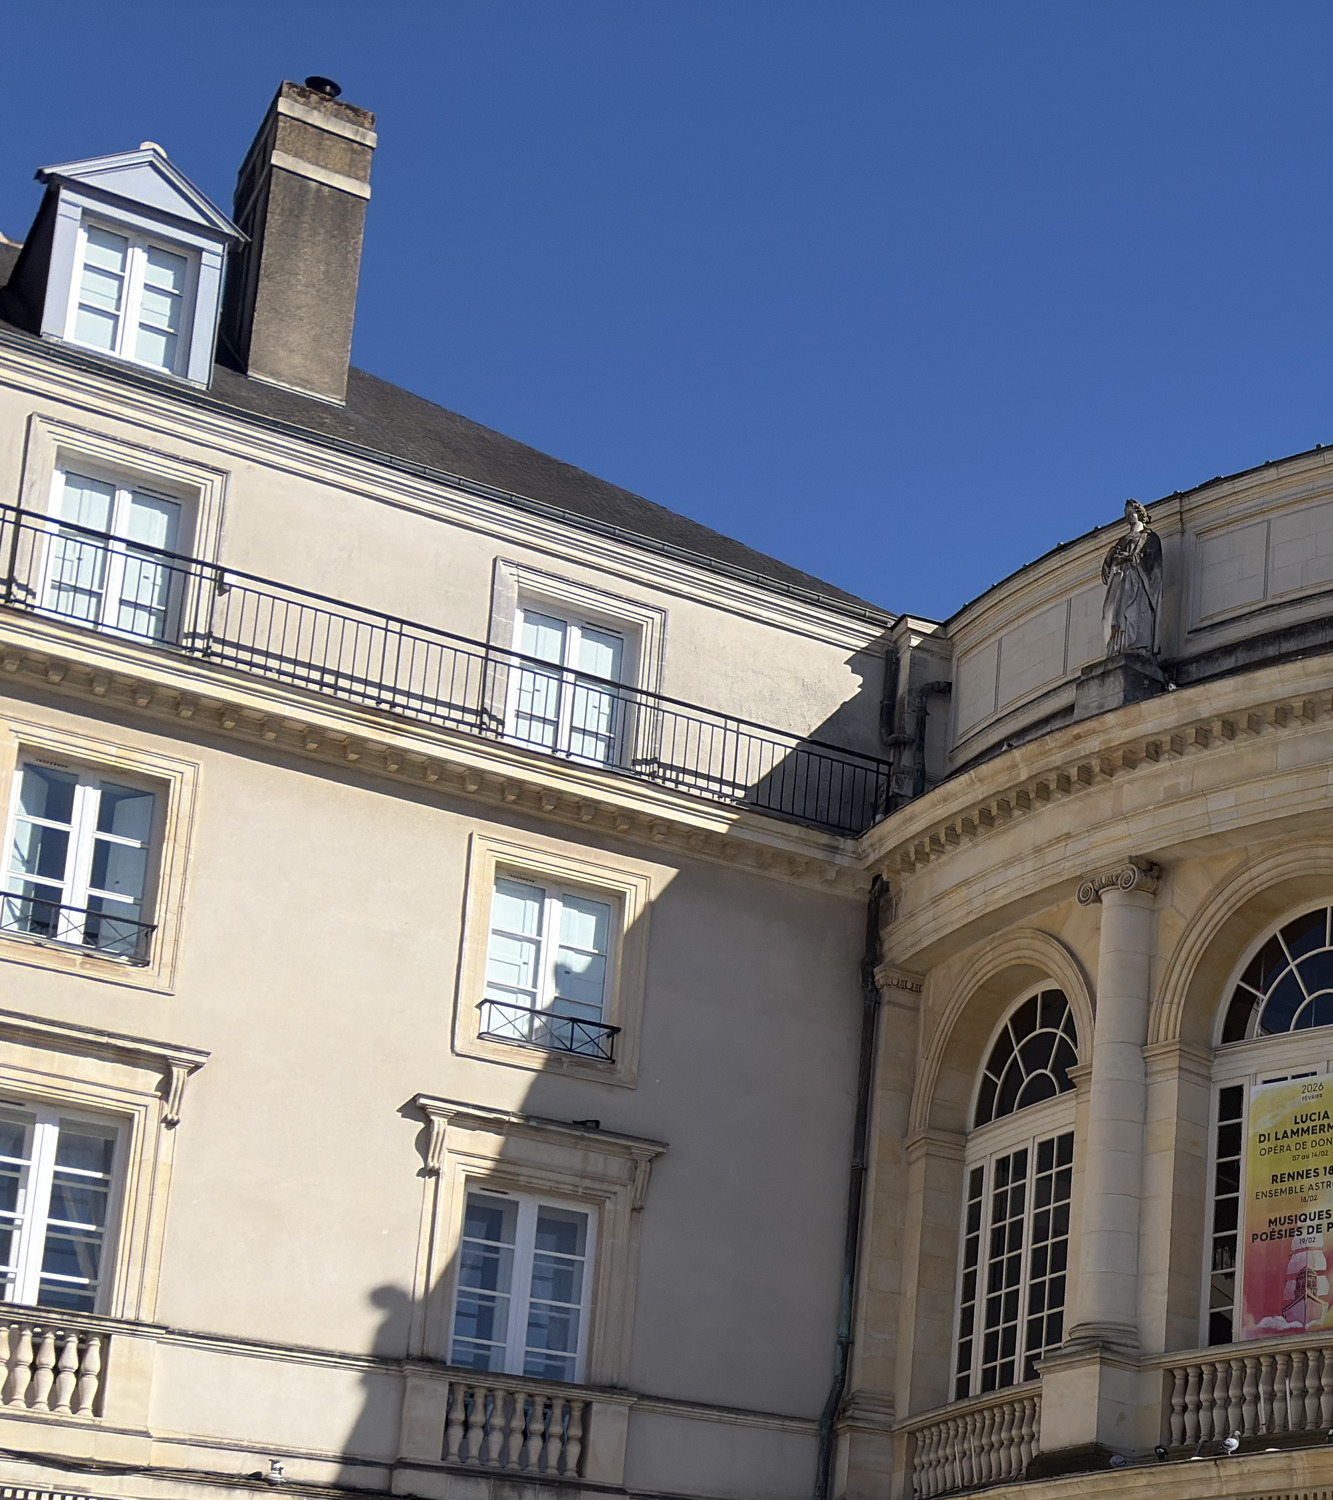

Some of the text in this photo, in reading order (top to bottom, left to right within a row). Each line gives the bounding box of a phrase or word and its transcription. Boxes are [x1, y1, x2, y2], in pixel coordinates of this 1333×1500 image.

[1301, 1082, 1324, 1094] 2026
[1293, 1110, 1330, 1125] LUCIA
[1258, 1132, 1271, 1144] DI
[1259, 1143, 1292, 1157] OPÉRA
[1294, 1141, 1308, 1151] DE
[1311, 1149, 1329, 1159] 14/02
[1271, 1167, 1320, 1185] RENNES
[1255, 1184, 1305, 1200] ENSEMBLE
[1268, 1209, 1332, 1228] MUSIQUES
[1251, 1226, 1303, 1243] POÉSIES
[1306, 1223, 1323, 1235] DE
[1299, 1236, 1316, 1245] 19/02
